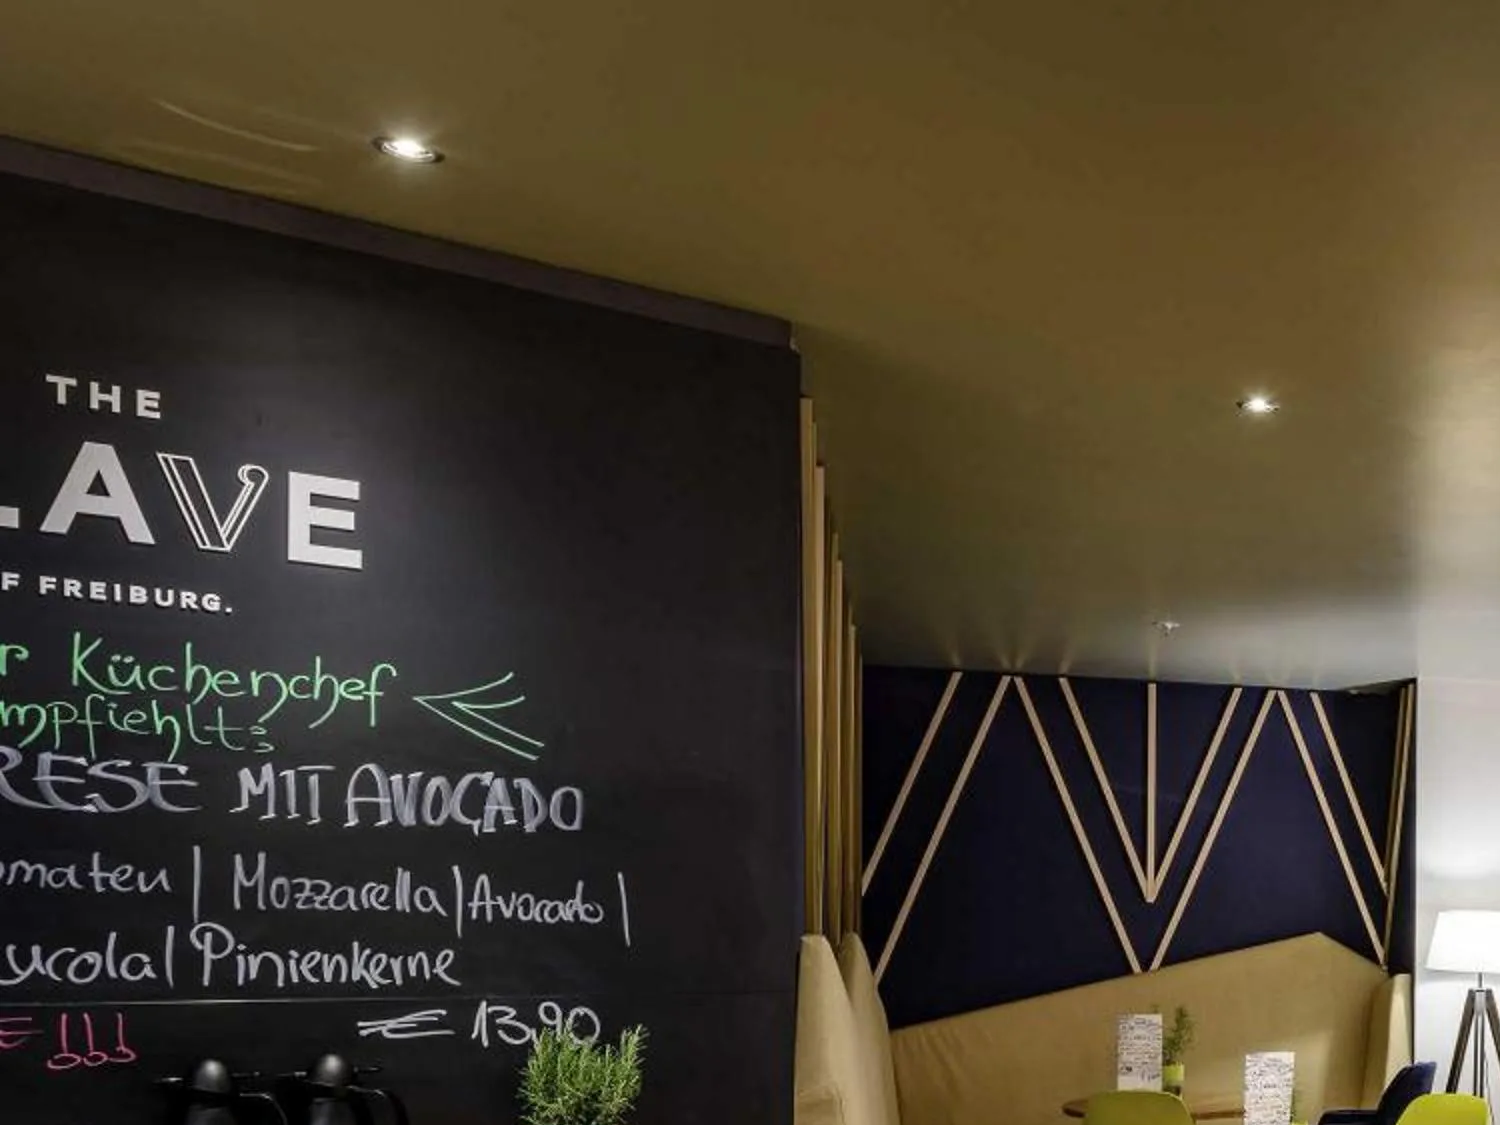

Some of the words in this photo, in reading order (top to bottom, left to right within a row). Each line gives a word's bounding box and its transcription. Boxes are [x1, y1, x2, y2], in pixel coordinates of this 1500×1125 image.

[45, 374, 161, 419] THE
[39, 575, 233, 614] FREIBURG.
[71, 631, 398, 729] Küchenchef
[229, 761, 336, 826] MIT
